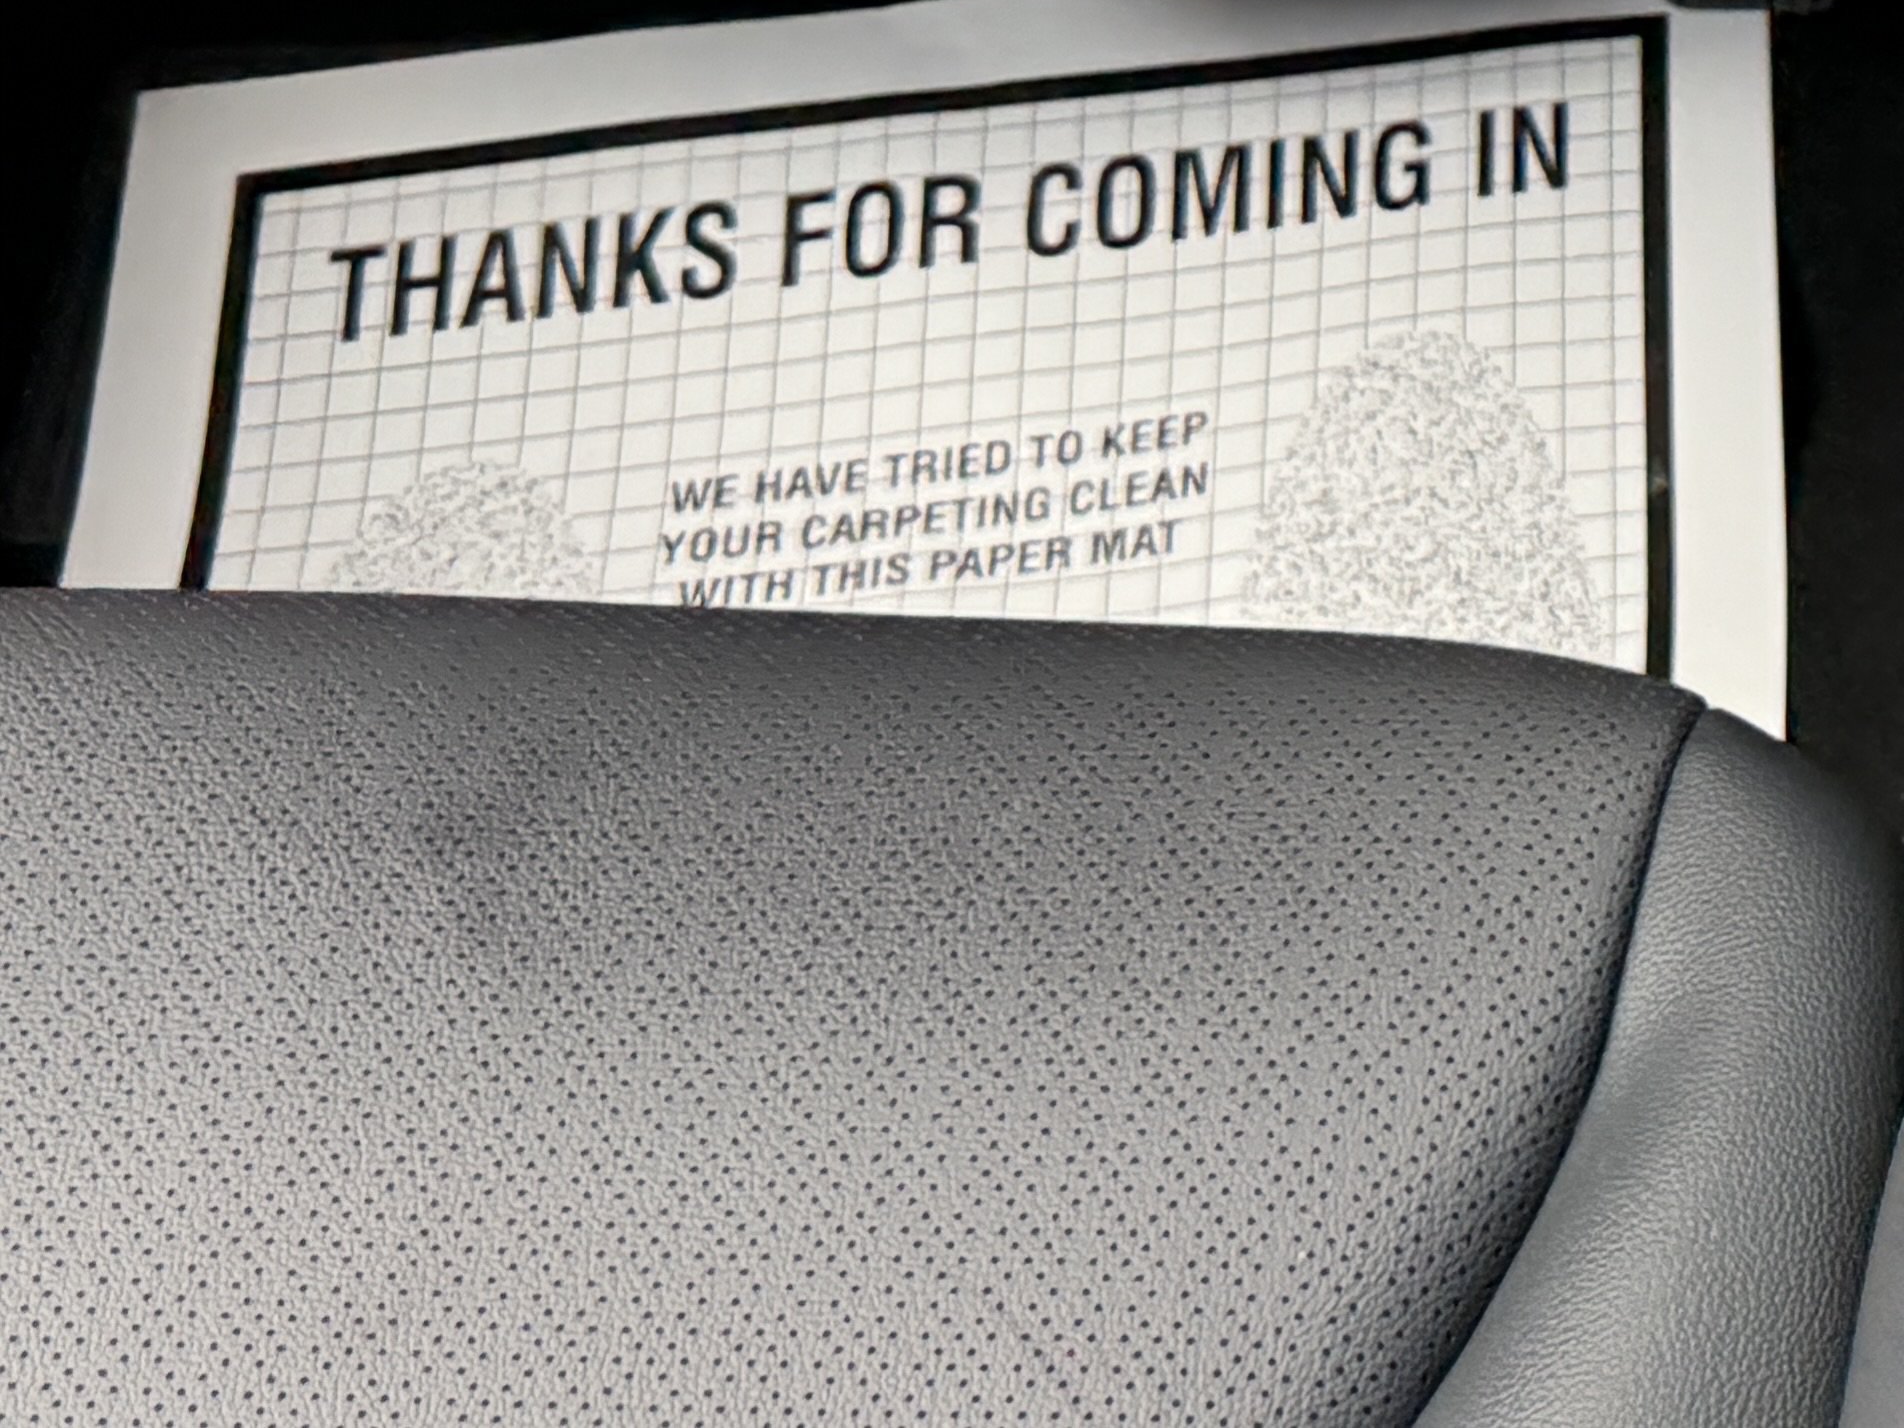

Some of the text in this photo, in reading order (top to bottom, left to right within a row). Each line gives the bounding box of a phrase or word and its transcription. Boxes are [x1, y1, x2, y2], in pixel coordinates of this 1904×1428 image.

[331, 100, 1569, 342] THANKS FOR COMING IN
[661, 461, 1208, 565] YOUR CARPETING CLEAN
[673, 411, 1208, 513] WE HAVE TRIED TO KEEP
[680, 518, 1181, 609] WITH THIS PAPER MAT
